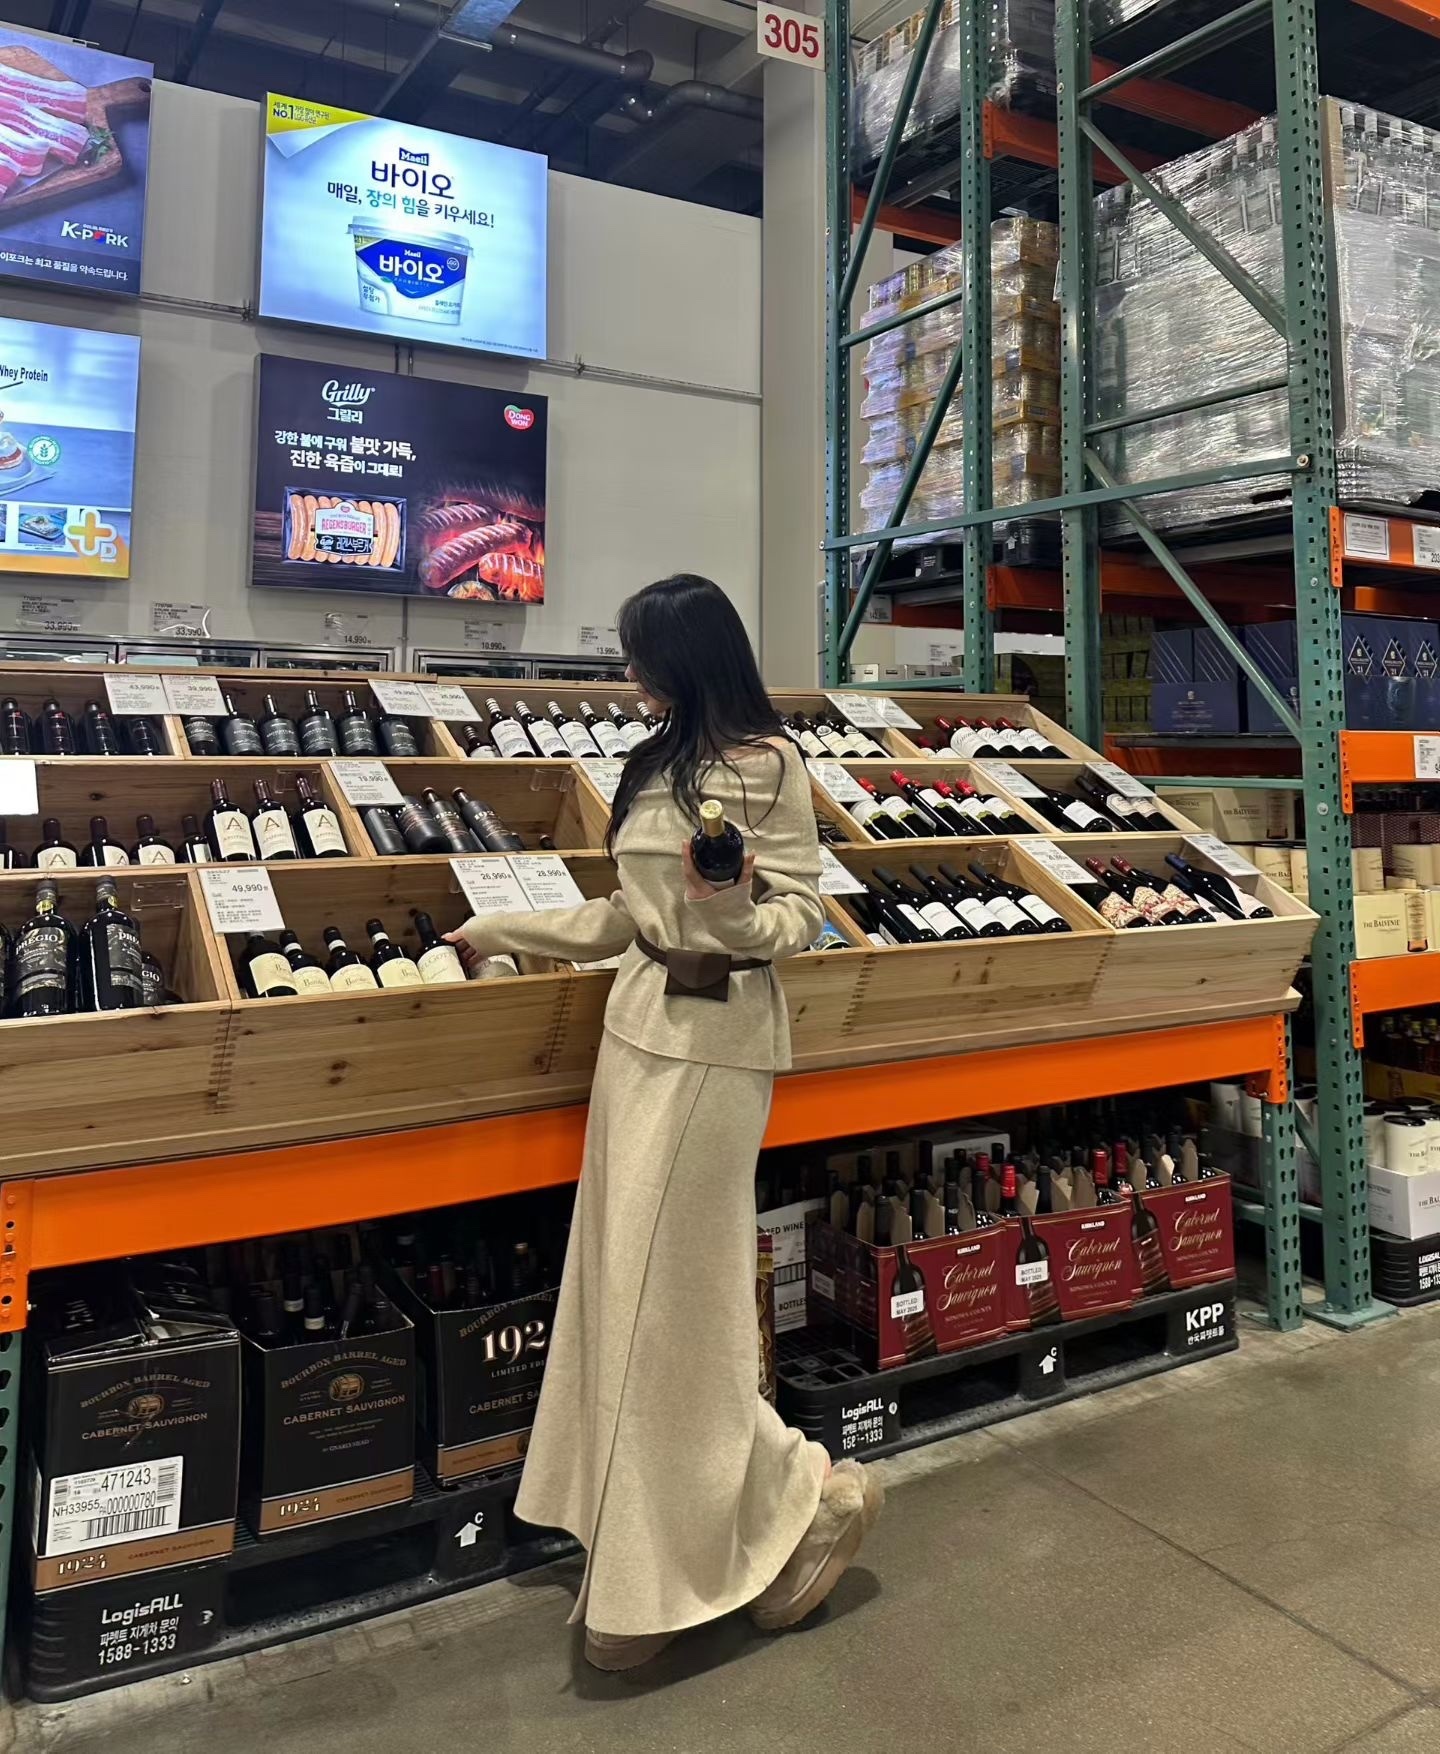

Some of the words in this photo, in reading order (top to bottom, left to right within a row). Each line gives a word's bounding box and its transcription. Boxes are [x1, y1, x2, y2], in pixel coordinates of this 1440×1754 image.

[765, 13, 819, 58] 305
[401, 152, 428, 165] Maeil
[371, 161, 455, 199] 바이오
[327, 182, 362, 205] 매일,
[366, 189, 396, 209] 장의
[402, 196, 430, 217] 힘을
[434, 203, 494, 228] 키우세요!
[0, 252, 34, 266] 이포크는
[35, 257, 52, 268] 최고
[53, 260, 78, 273] 품질을
[80, 265, 128, 281] 약속드립니다.
[379, 254, 445, 284] 바이오
[20, 367, 48, 382] Protein
[322, 380, 372, 406] Grilly
[327, 408, 363, 424] 그릴리
[508, 410, 531, 421] DONG
[511, 419, 529, 427] WON
[274, 431, 298, 445] 강한
[300, 433, 323, 448] 불에
[324, 436, 347, 452] 구워
[350, 435, 380, 456] 불맛
[383, 440, 416, 462] 가득,
[290, 449, 322, 470] 진한
[324, 454, 365, 474] 육즙이
[227, 817, 243, 830] A
[264, 816, 280, 832] A
[318, 814, 333, 828] A
[50, 853, 67, 865] A
[117, 855, 129, 865] A
[783, 1222, 805, 1233] WINE
[1172, 1208, 1220, 1233] Cabernet
[1065, 1237, 1121, 1262] Cabernet
[942, 1260, 996, 1290] Cabernet
[1061, 1259, 1122, 1281] Sauvignon
[936, 1284, 998, 1312] Sauvignon
[1186, 1303, 1224, 1332] KPP
[481, 1320, 546, 1365] 192
[1050, 1347, 1057, 1357] C
[281, 1358, 332, 1389] BOURBON
[333, 1351, 379, 1362] BARREL
[381, 1355, 407, 1366] AGED
[491, 1365, 528, 1378] LIMITED
[80, 1380, 131, 1408] BOURBON
[134, 1373, 180, 1384] BARREL
[181, 1377, 211, 1388] AGED
[283, 1407, 343, 1425] CABERNET
[345, 1394, 406, 1414] SAUVIGNON
[469, 1393, 524, 1414] CABERNET
[842, 1397, 884, 1421] LogisALL
[82, 1424, 141, 1440] CABERNET
[145, 1412, 208, 1429] SAUVIGNON
[101, 1467, 152, 1492] 471243
[53, 1499, 100, 1518] NH33955
[474, 1512, 484, 1524] C
[57, 1552, 108, 1575] 1924
[101, 1593, 184, 1626] LogisALL
[100, 1628, 128, 1648] 파렛트
[130, 1621, 158, 1641] 지게차
[159, 1616, 180, 1634] 문의
[98, 1633, 177, 1666] 1588-1333
